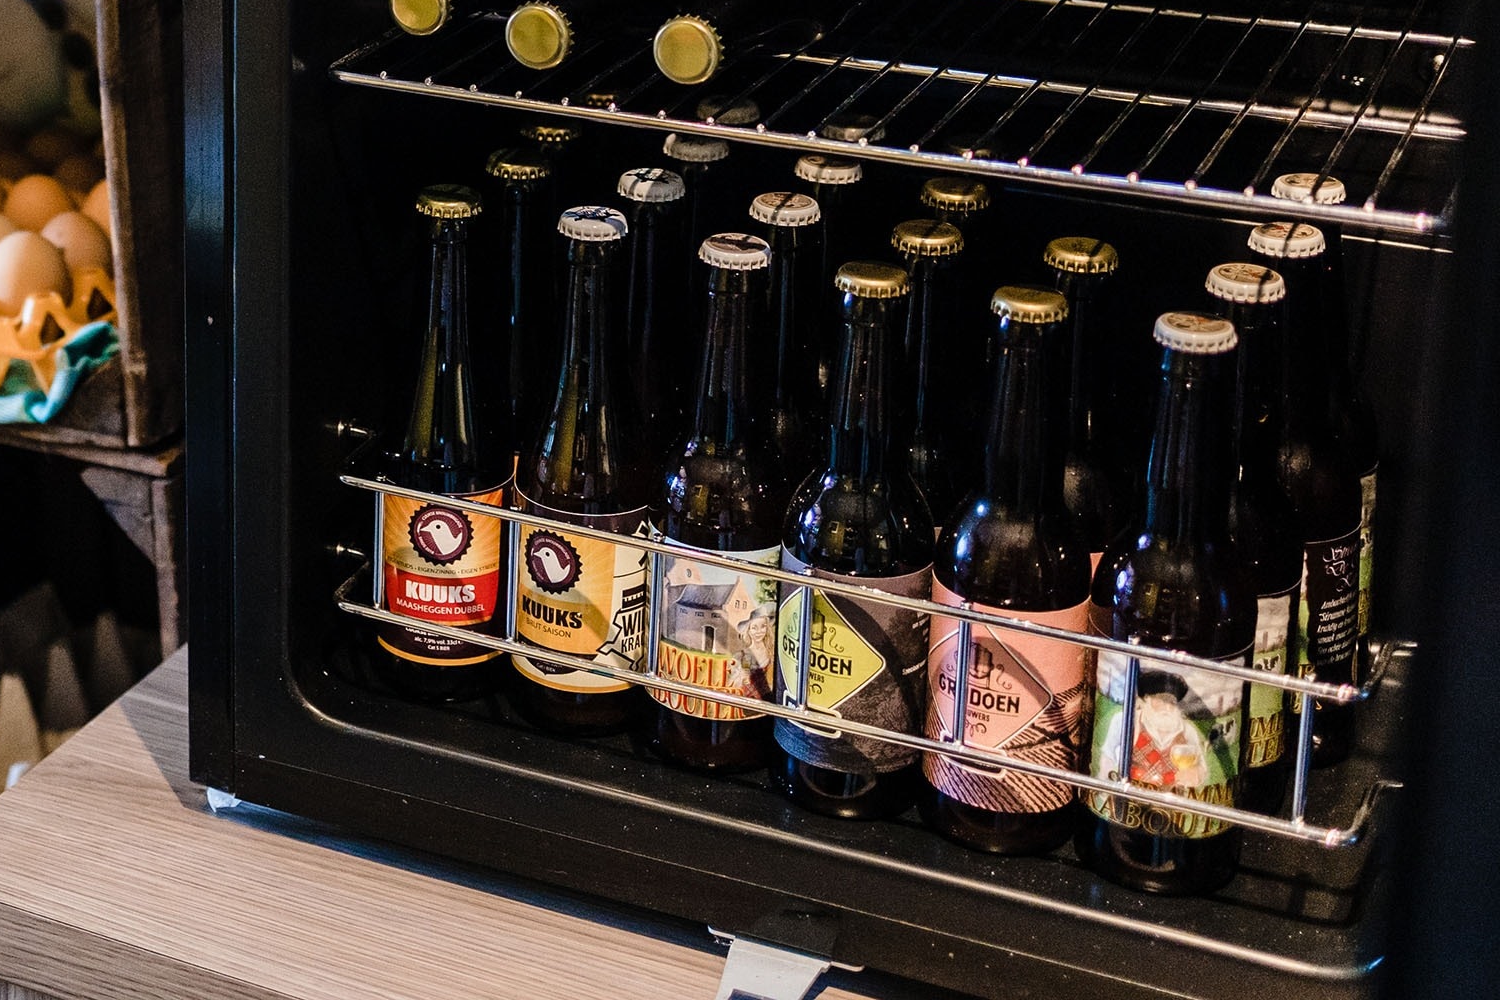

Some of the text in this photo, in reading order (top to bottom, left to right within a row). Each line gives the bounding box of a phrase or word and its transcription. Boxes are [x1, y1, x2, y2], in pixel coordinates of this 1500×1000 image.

[396, 598, 485, 615] MAASHEGGEN DUBBEL
[405, 580, 476, 604] KUUKS
[522, 594, 583, 629] KUUKS
[526, 617, 571, 638] BRUT SAISON
[782, 634, 852, 676] GRDOEN
[939, 673, 1020, 714] GRDOEN
